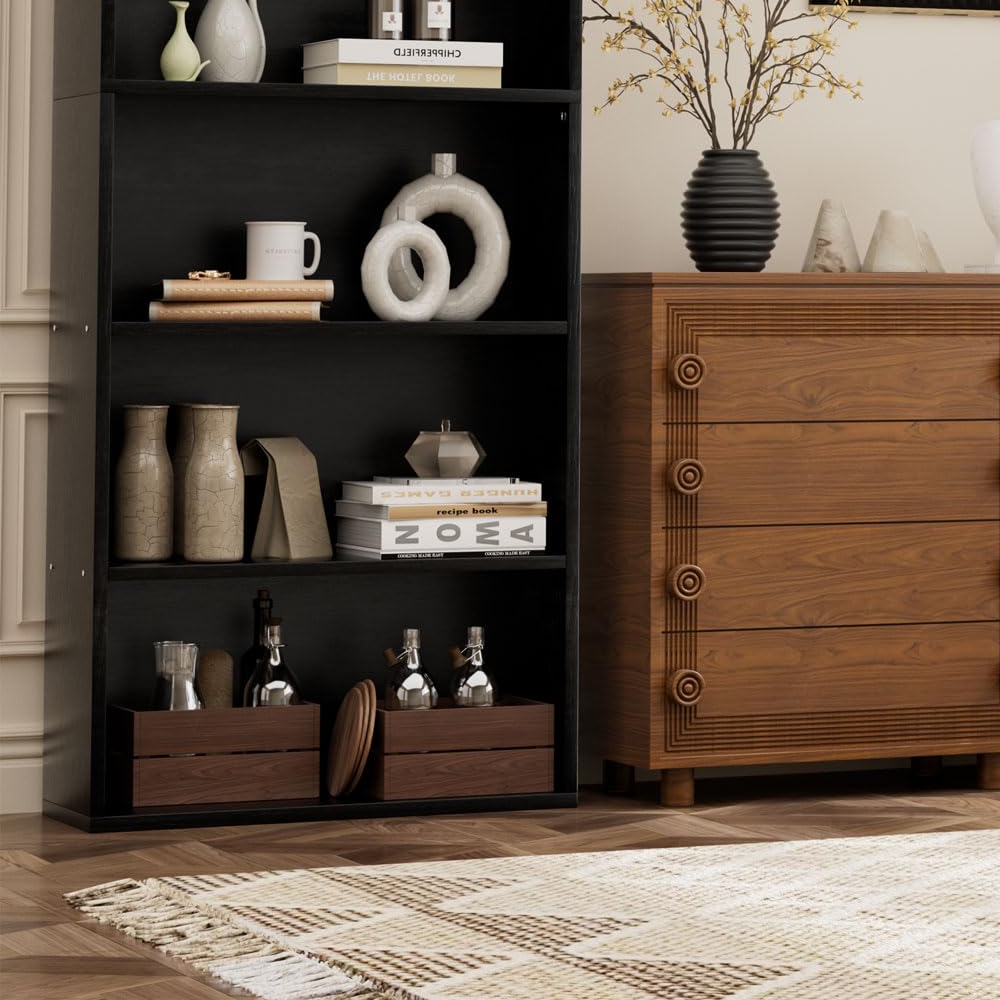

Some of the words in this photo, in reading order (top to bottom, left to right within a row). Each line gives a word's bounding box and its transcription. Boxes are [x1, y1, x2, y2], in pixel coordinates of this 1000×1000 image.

[436, 508, 469, 516] recipe
[472, 507, 499, 515] book
[395, 521, 534, 545] NOMA
